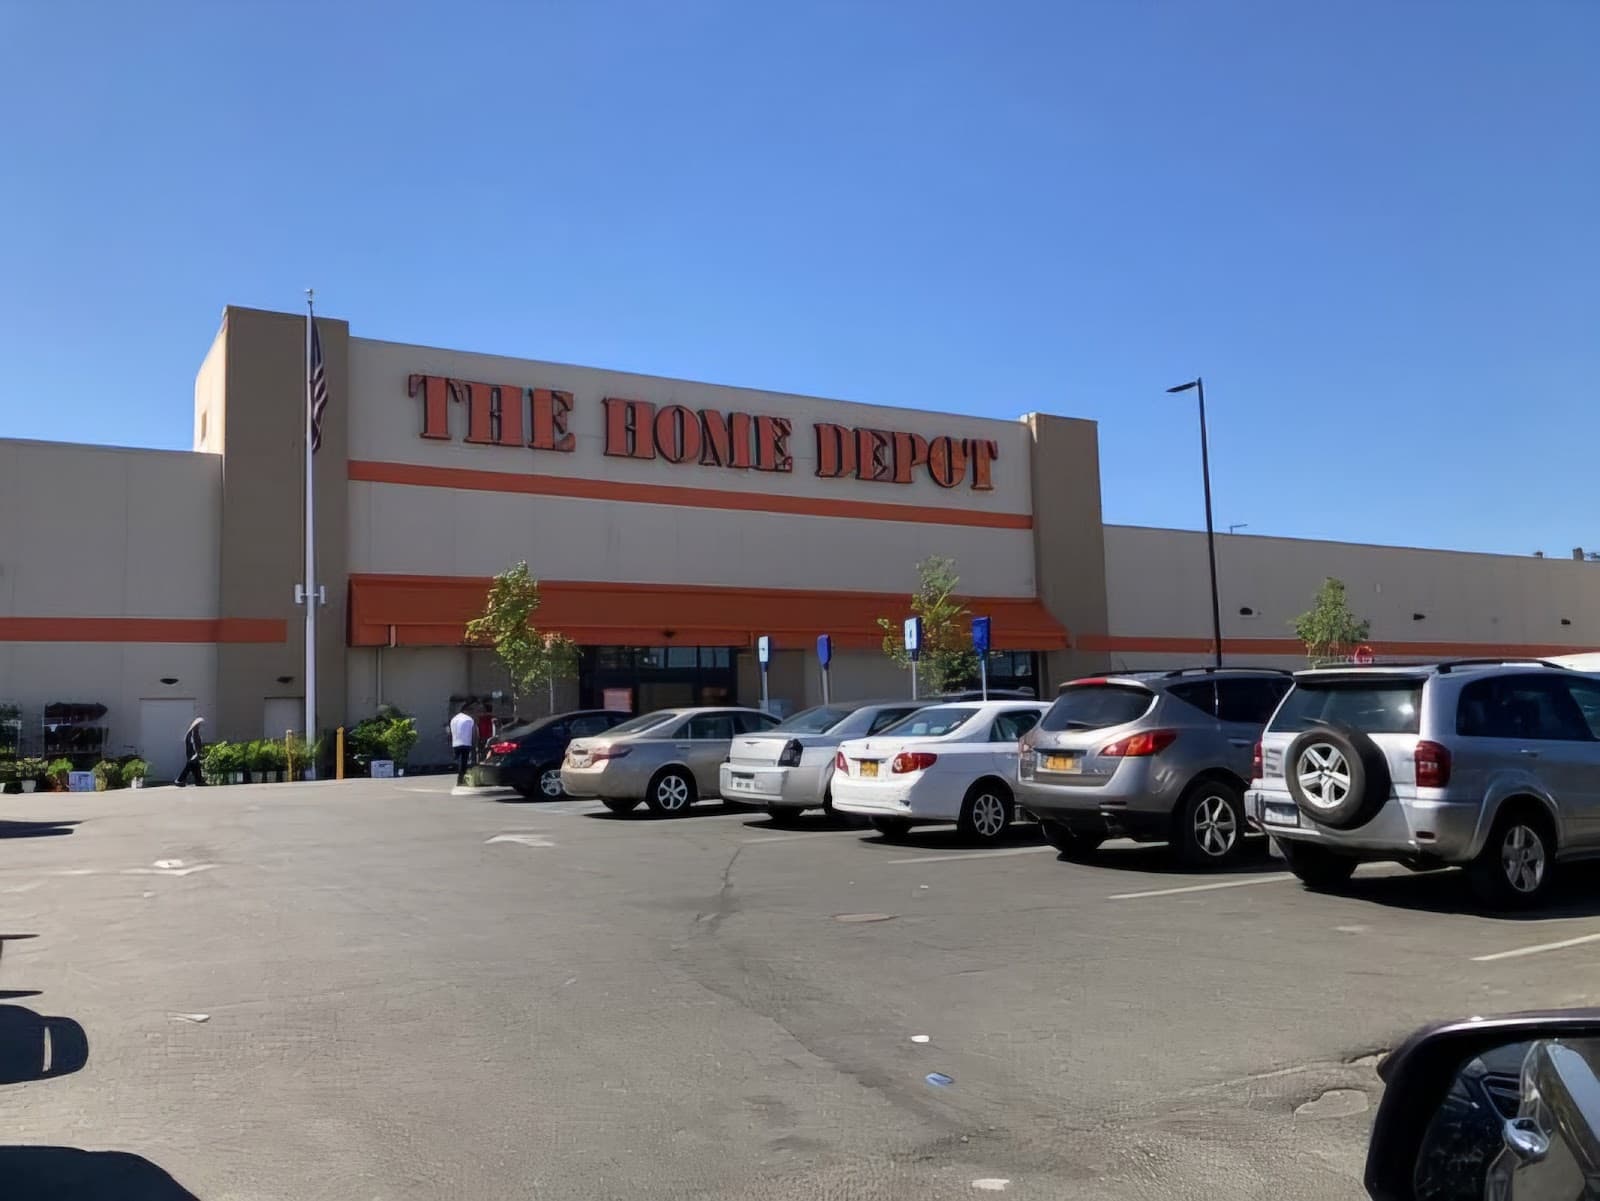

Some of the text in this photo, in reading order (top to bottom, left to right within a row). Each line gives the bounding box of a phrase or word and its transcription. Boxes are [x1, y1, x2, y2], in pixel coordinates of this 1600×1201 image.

[408, 373, 999, 491] THE HOME DEPOT
